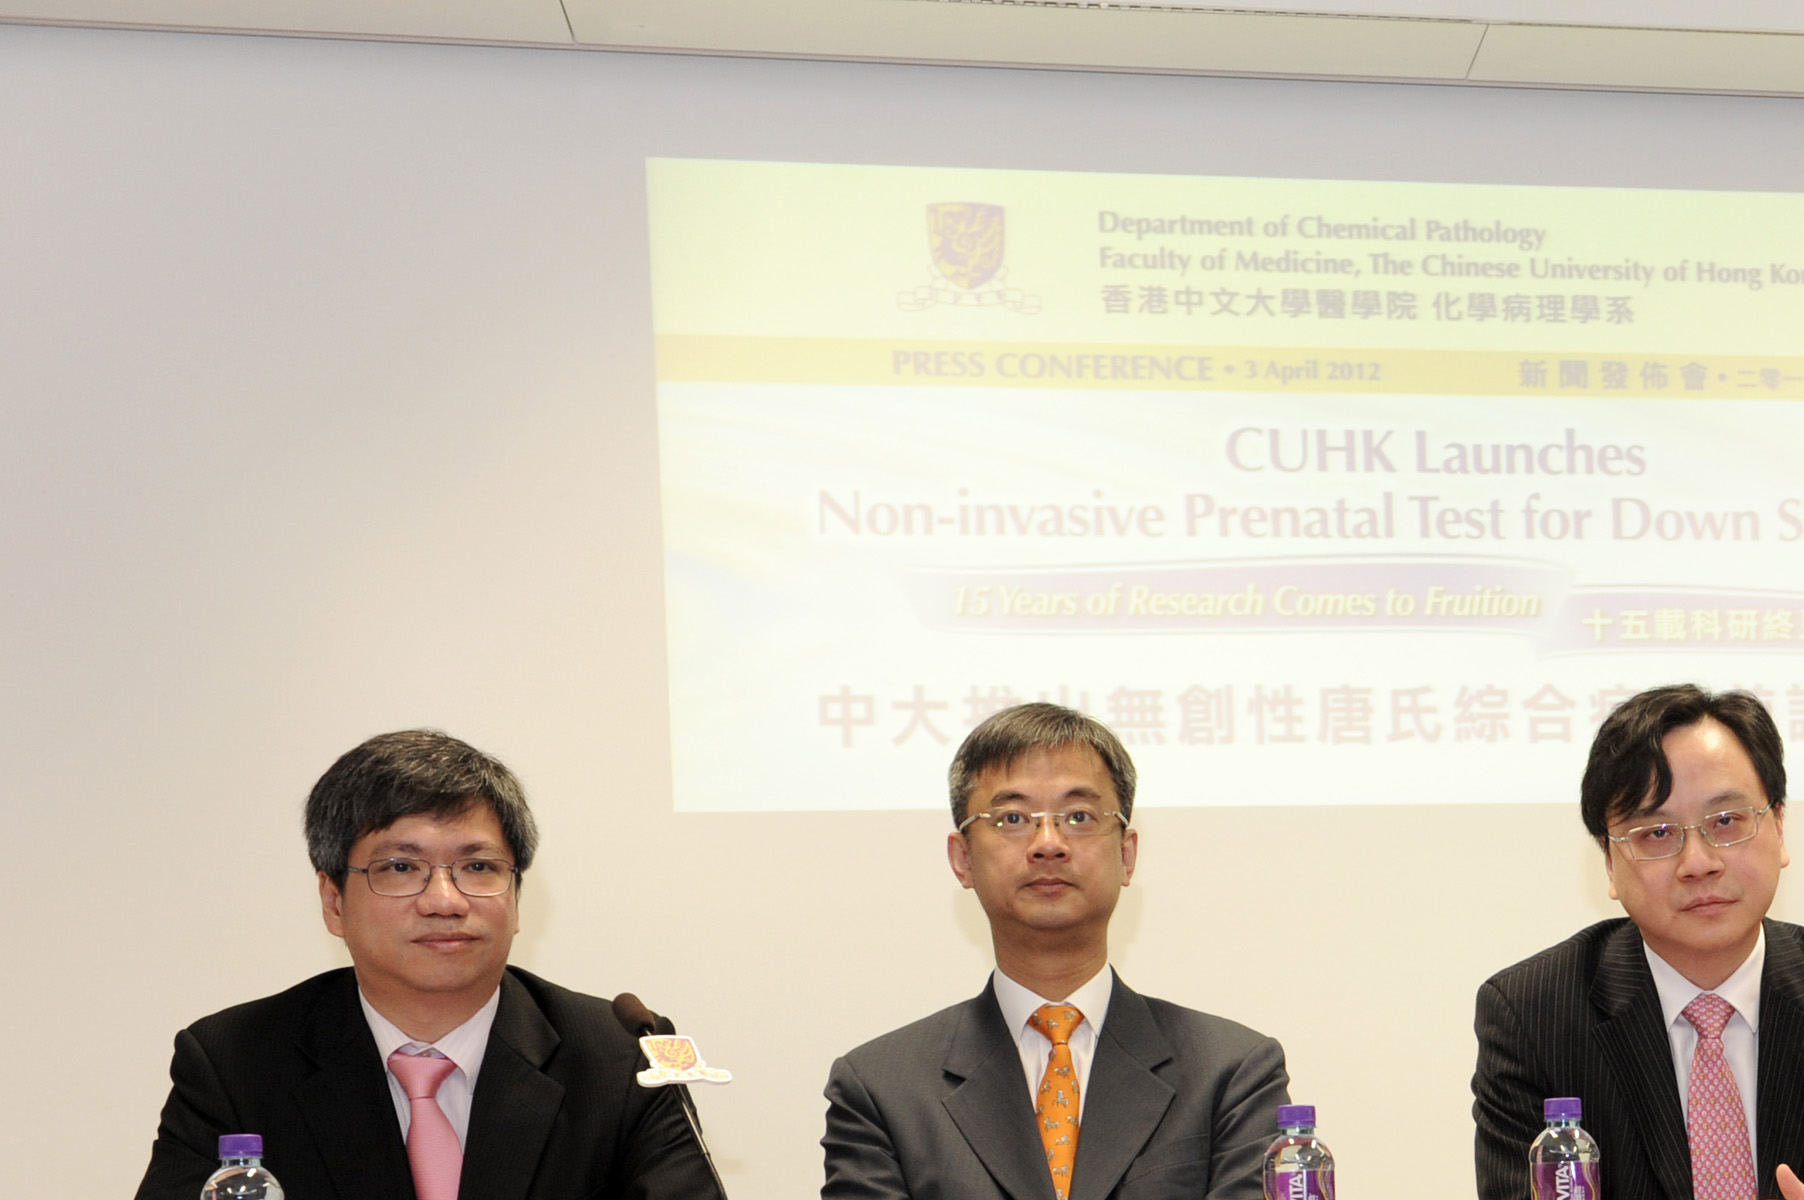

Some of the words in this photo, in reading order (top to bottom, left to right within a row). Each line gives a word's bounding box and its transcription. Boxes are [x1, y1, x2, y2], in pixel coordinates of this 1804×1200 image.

[1098, 210, 1255, 239] Department
[1263, 212, 1292, 238] of
[1297, 215, 1416, 241] Chemical
[1425, 219, 1547, 250] Pathology
[1099, 246, 1191, 276] Faculty
[1201, 249, 1229, 273] of
[1235, 249, 1362, 277] Medicine,
[1370, 251, 1415, 275] The
[1422, 254, 1521, 279] Chinese
[1529, 257, 1655, 286] University
[1662, 259, 1689, 283] of
[1696, 260, 1763, 290] Hong
[1100, 285, 1418, 321] 香港中文大學醫學院
[1432, 291, 1635, 324] 化學病理學系
[892, 350, 986, 378] PRESS
[996, 352, 1213, 382] CONFERENCE
[1243, 360, 1257, 380] 3
[1264, 359, 1318, 386] April
[1327, 361, 1381, 382] 2012
[1518, 360, 1709, 392] 新聞發佈會
[1226, 427, 1396, 475] CUHK
[1415, 428, 1647, 477] Launches
[818, 489, 1165, 539] Non-invasive
[1186, 492, 1394, 540] Prenatal
[1407, 496, 1505, 541] Test
[1522, 493, 1591, 541] for
[1612, 498, 1761, 543] Down
[953, 585, 988, 616] 15
[1000, 584, 1078, 617] Years
[1087, 583, 1121, 617] of
[1129, 584, 1264, 616] Research
[1274, 585, 1375, 617] Comes
[1386, 588, 1414, 616] to
[1425, 586, 1540, 616] Fruition
